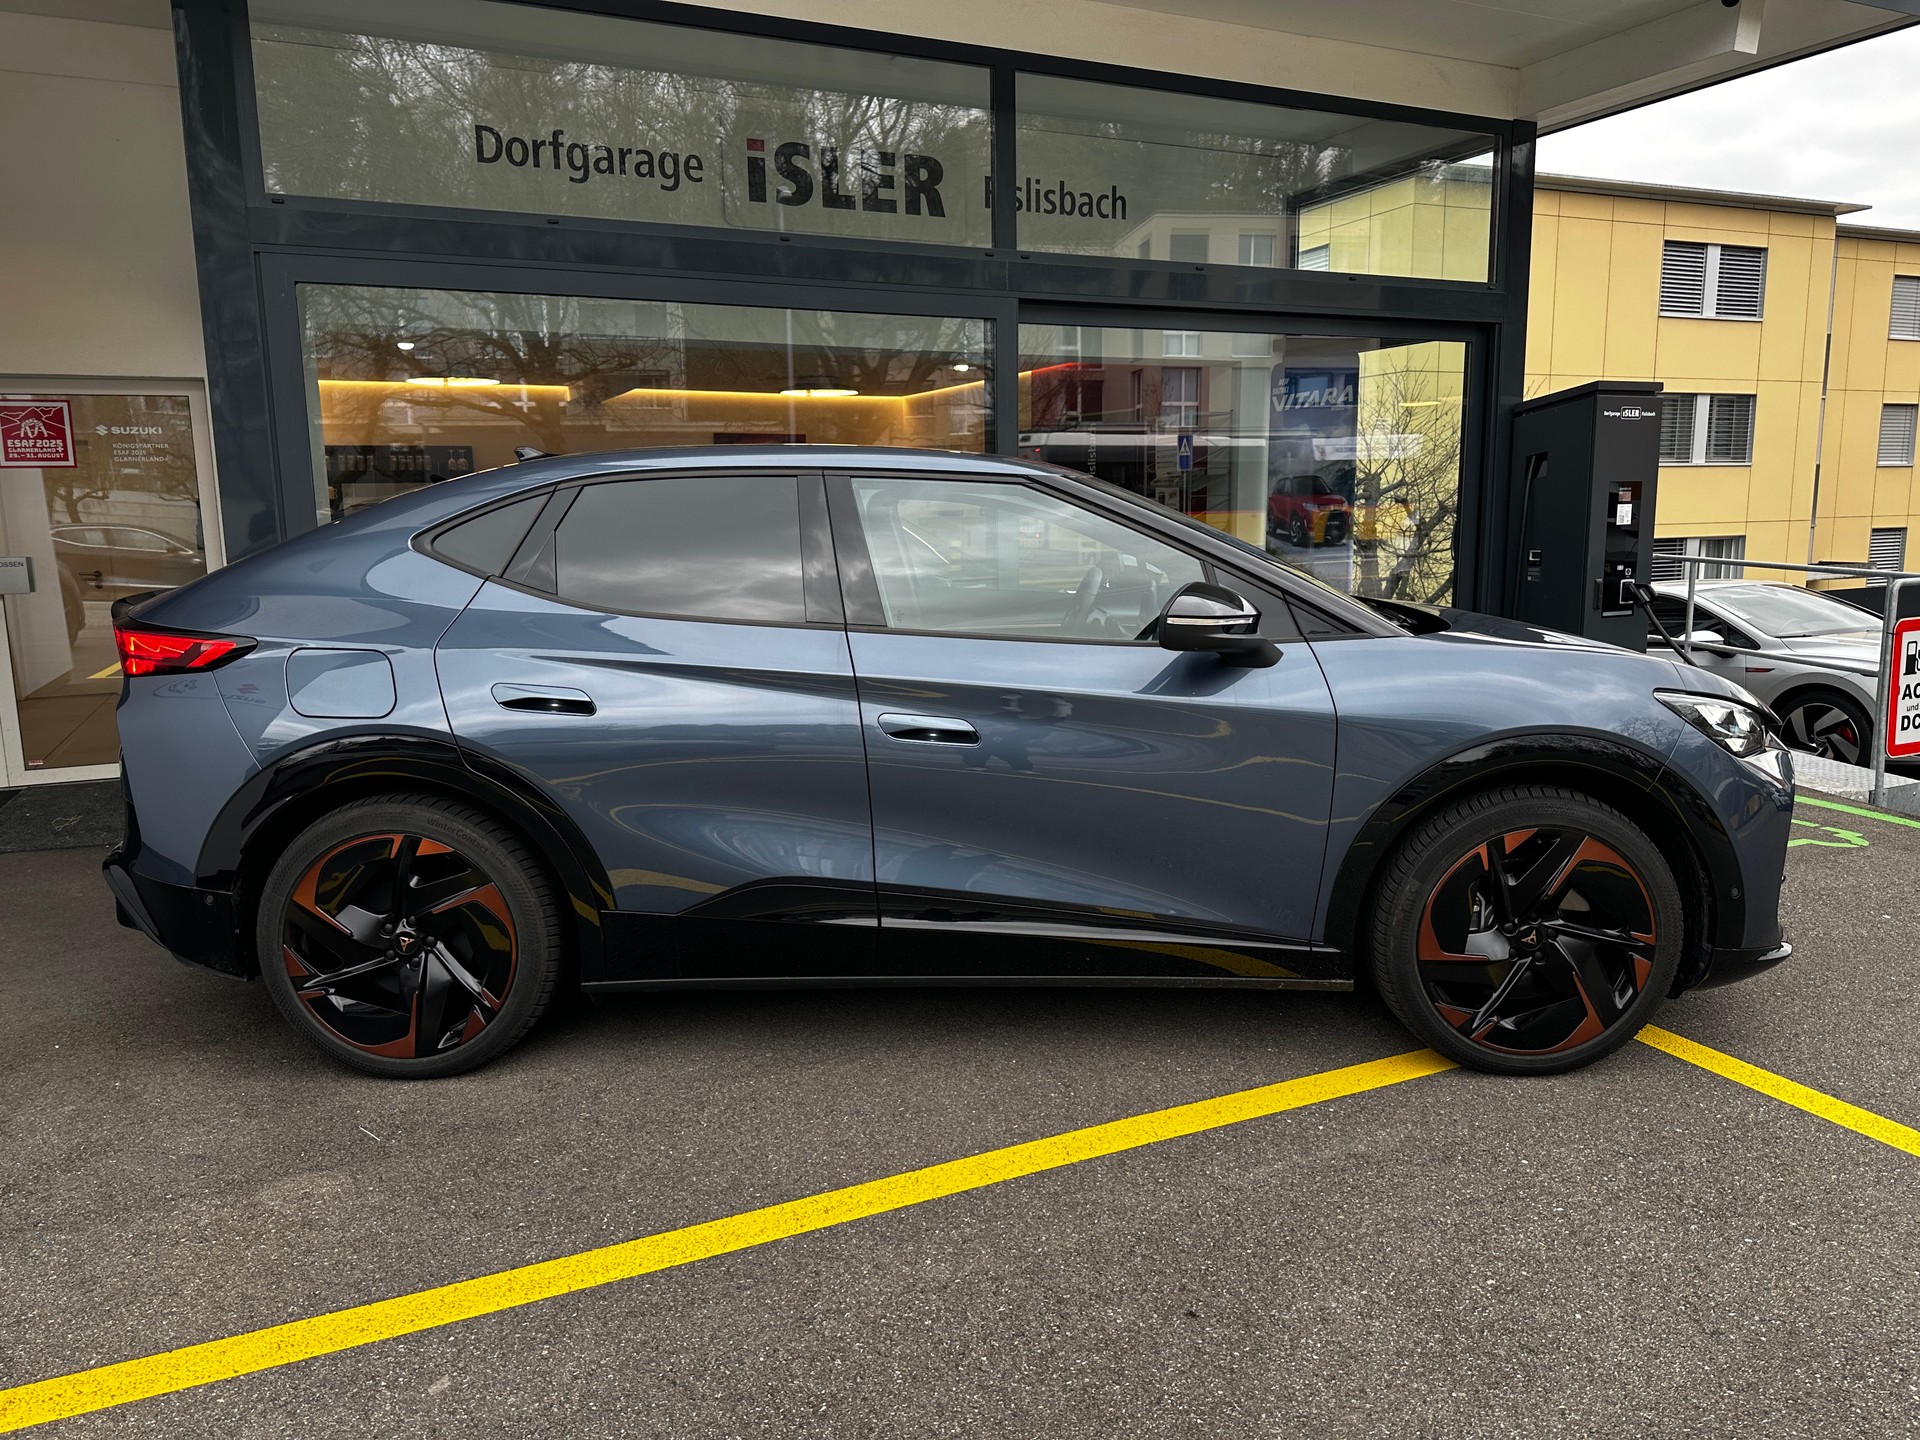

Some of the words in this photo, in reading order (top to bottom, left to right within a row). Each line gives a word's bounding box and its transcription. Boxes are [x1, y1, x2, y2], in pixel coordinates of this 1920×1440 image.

[474, 124, 704, 192] Dorfgarage
[746, 138, 946, 218] iSLER
[1272, 385, 1354, 412] VITARA
[111, 426, 162, 435] SUZUKI
[7, 439, 35, 448] ESAF
[36, 439, 63, 448] 2025
[1906, 703, 1919, 712] und
[427, 816, 489, 854] WinterContact
